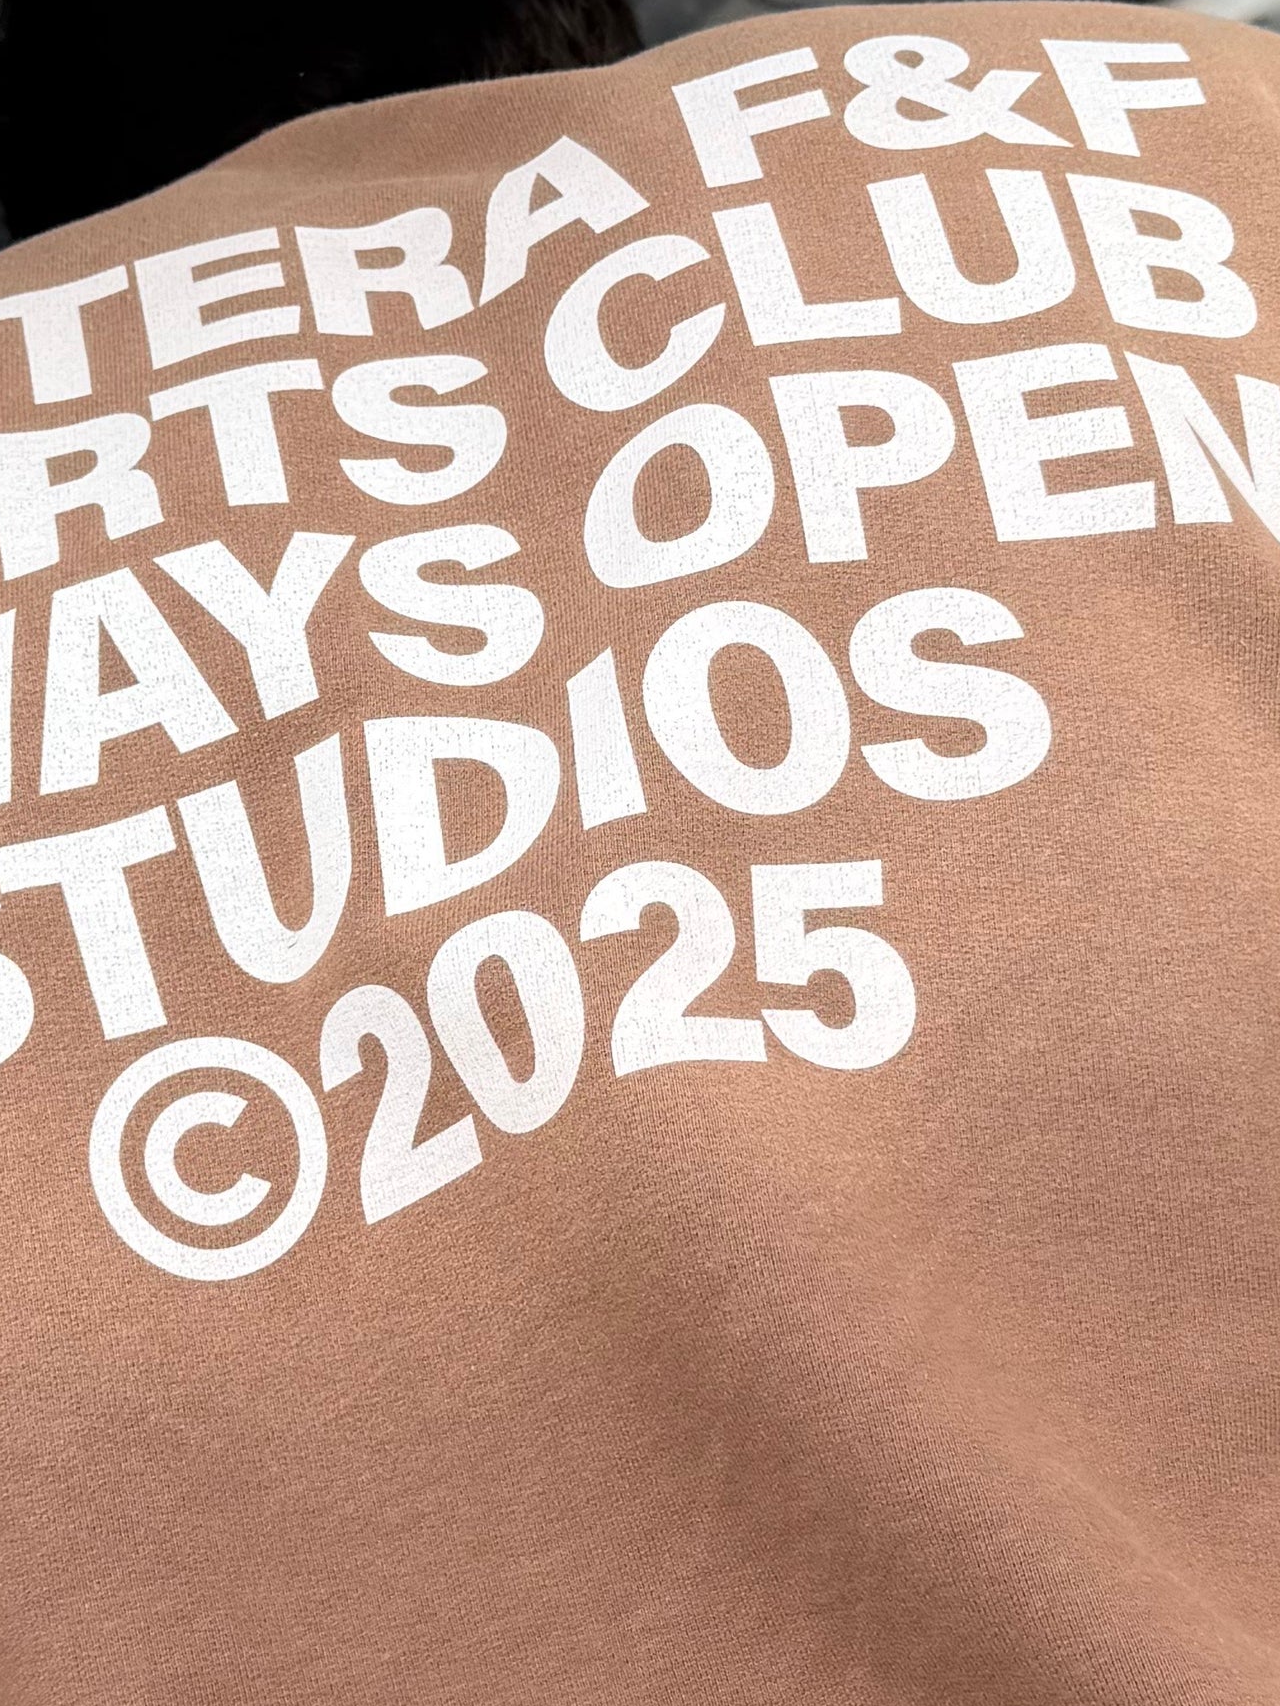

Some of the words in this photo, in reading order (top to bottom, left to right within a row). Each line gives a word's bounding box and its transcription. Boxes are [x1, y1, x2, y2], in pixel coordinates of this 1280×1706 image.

[672, 34, 1205, 187] F&F
[544, 168, 1258, 412] CLUB
[89, 860, 916, 1281] ©2025
